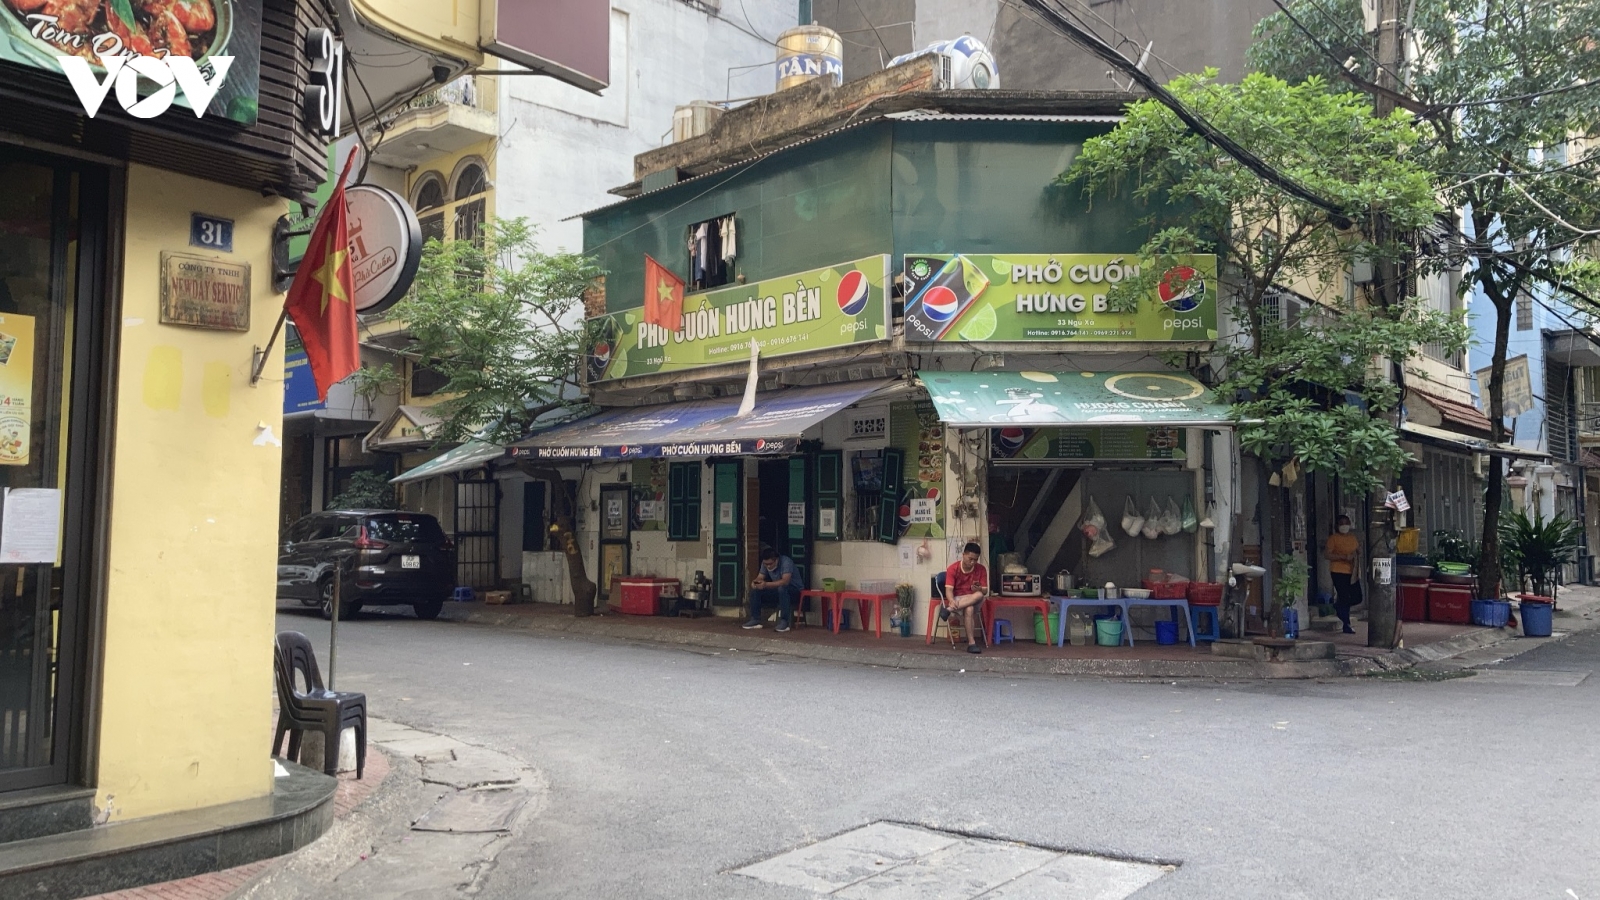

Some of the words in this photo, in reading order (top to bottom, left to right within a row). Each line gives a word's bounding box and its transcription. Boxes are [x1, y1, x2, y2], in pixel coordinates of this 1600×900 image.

[779, 56, 821, 79] TÂN
[318, 27, 343, 137] 31
[201, 221, 223, 246] 31
[178, 262, 203, 273] CÔNG
[204, 266, 216, 274] TY
[218, 268, 240, 278] TNHH
[1012, 258, 1063, 284] PHỞ
[1069, 256, 1141, 284] CUỐN
[725, 296, 777, 336] HƯNG
[782, 280, 822, 326] BỀN
[1016, 290, 1087, 314] HƯNG
[840, 316, 868, 336] pepsi
[906, 314, 935, 339] pepsi
[1163, 317, 1203, 331] pepsi
[708, 346, 729, 355] Hotline:
[730, 343, 744, 352] 0916
[770, 338, 785, 346] 0916
[552, 445, 569, 457] CUỐN
[570, 448, 588, 457] HƯNG
[678, 441, 700, 455] CUỐN
[701, 443, 724, 454] HƯNG
[765, 440, 784, 450] pepsi
